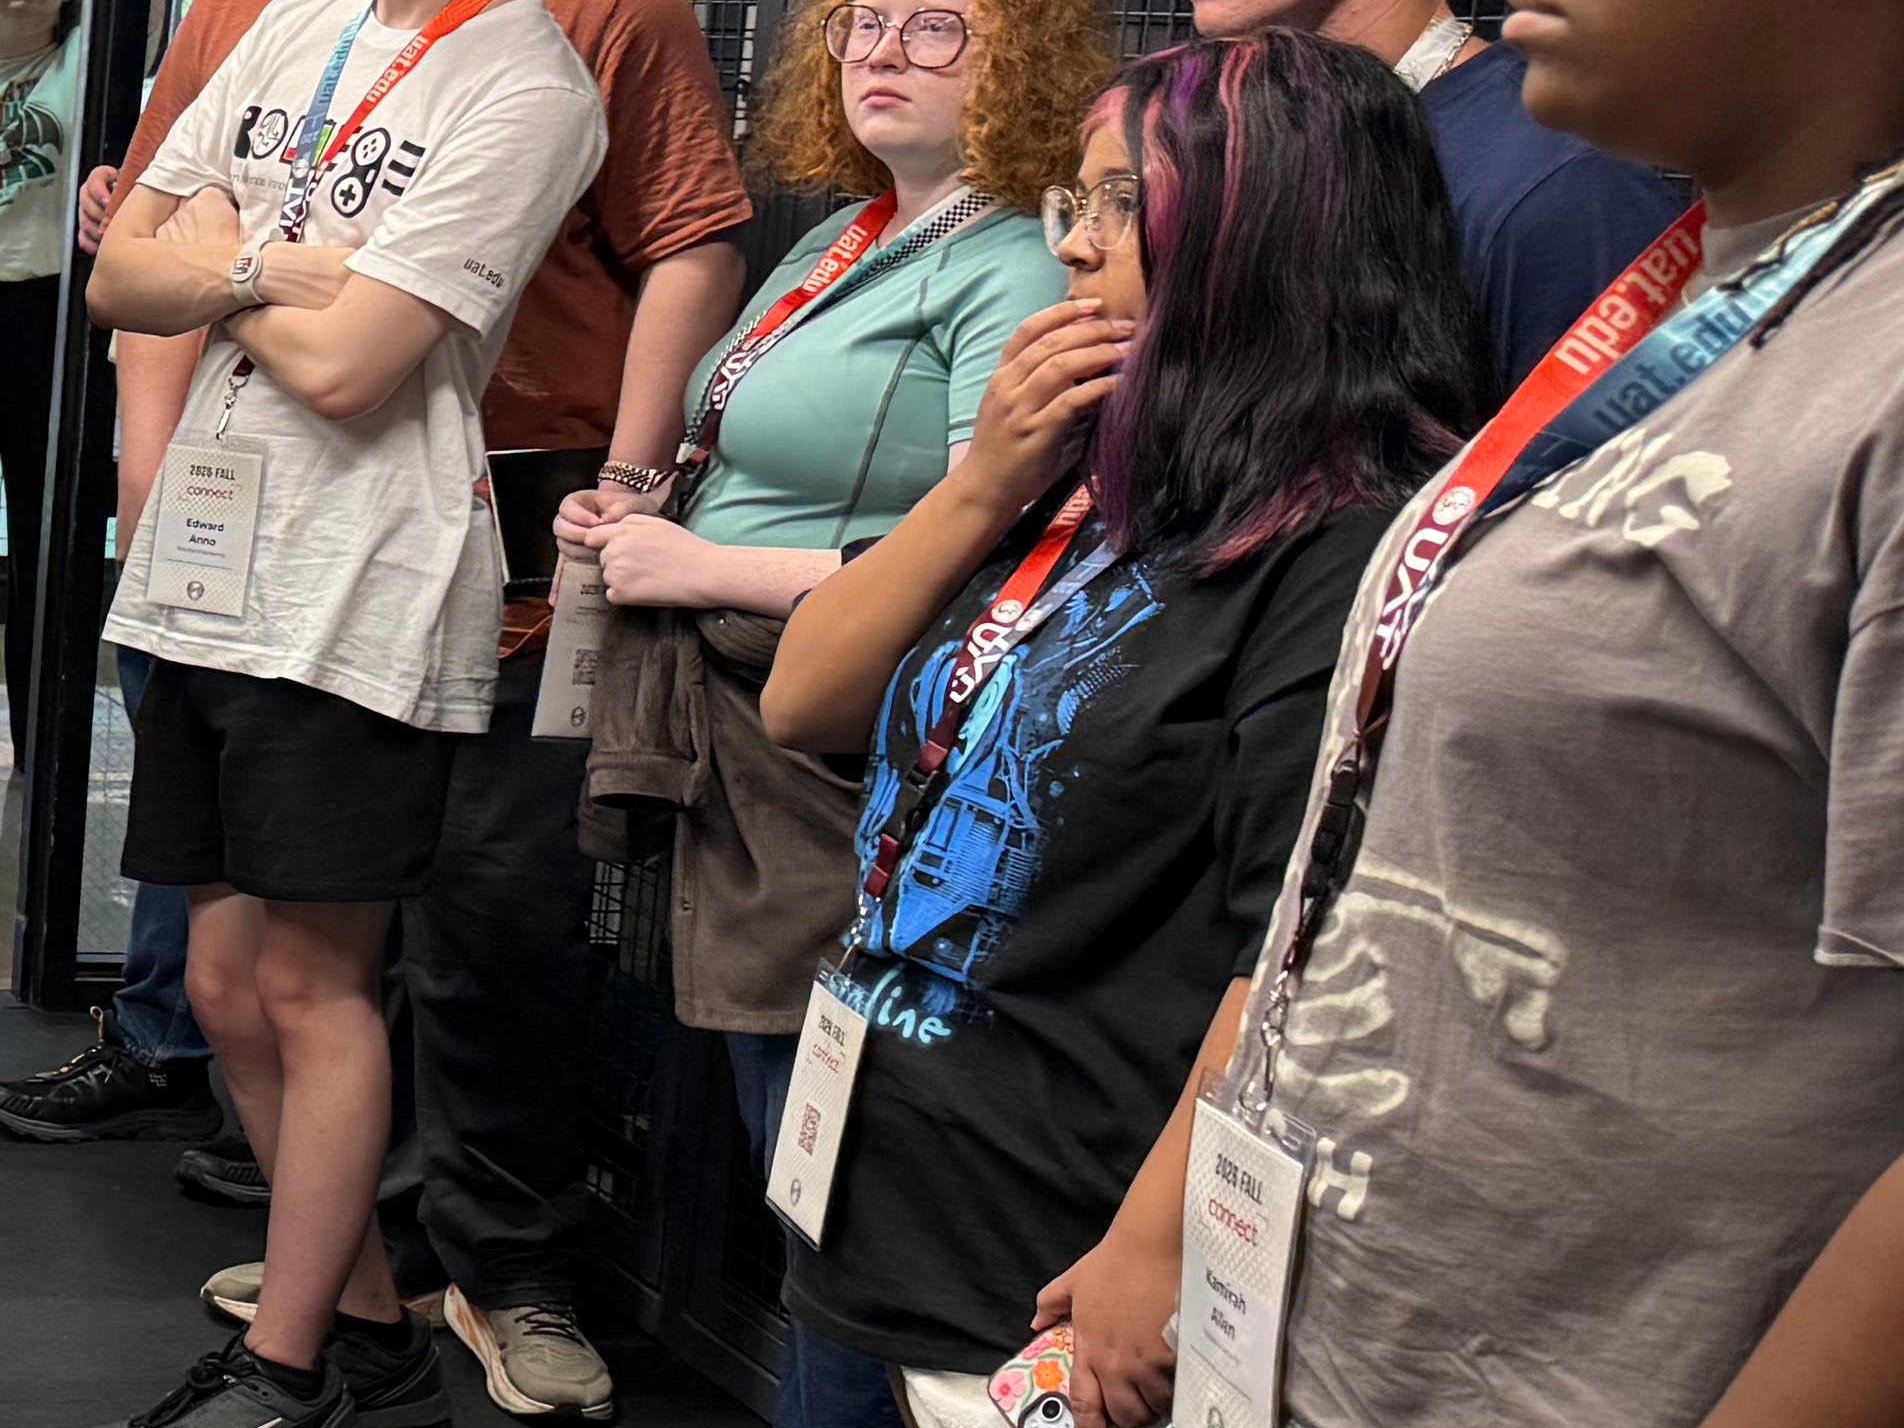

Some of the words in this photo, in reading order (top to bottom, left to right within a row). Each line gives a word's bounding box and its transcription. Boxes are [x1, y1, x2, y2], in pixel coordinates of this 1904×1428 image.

[366, 34, 429, 105] uat.edu
[803, 224, 868, 296] uat.edu
[1554, 224, 1700, 375] uat.edu
[1595, 300, 1754, 435] uat.edu
[186, 485, 234, 501] connect
[215, 467, 236, 480] FALL
[186, 518, 225, 532] Edward
[189, 534, 217, 546] Anno
[1208, 1198, 1258, 1247] connect
